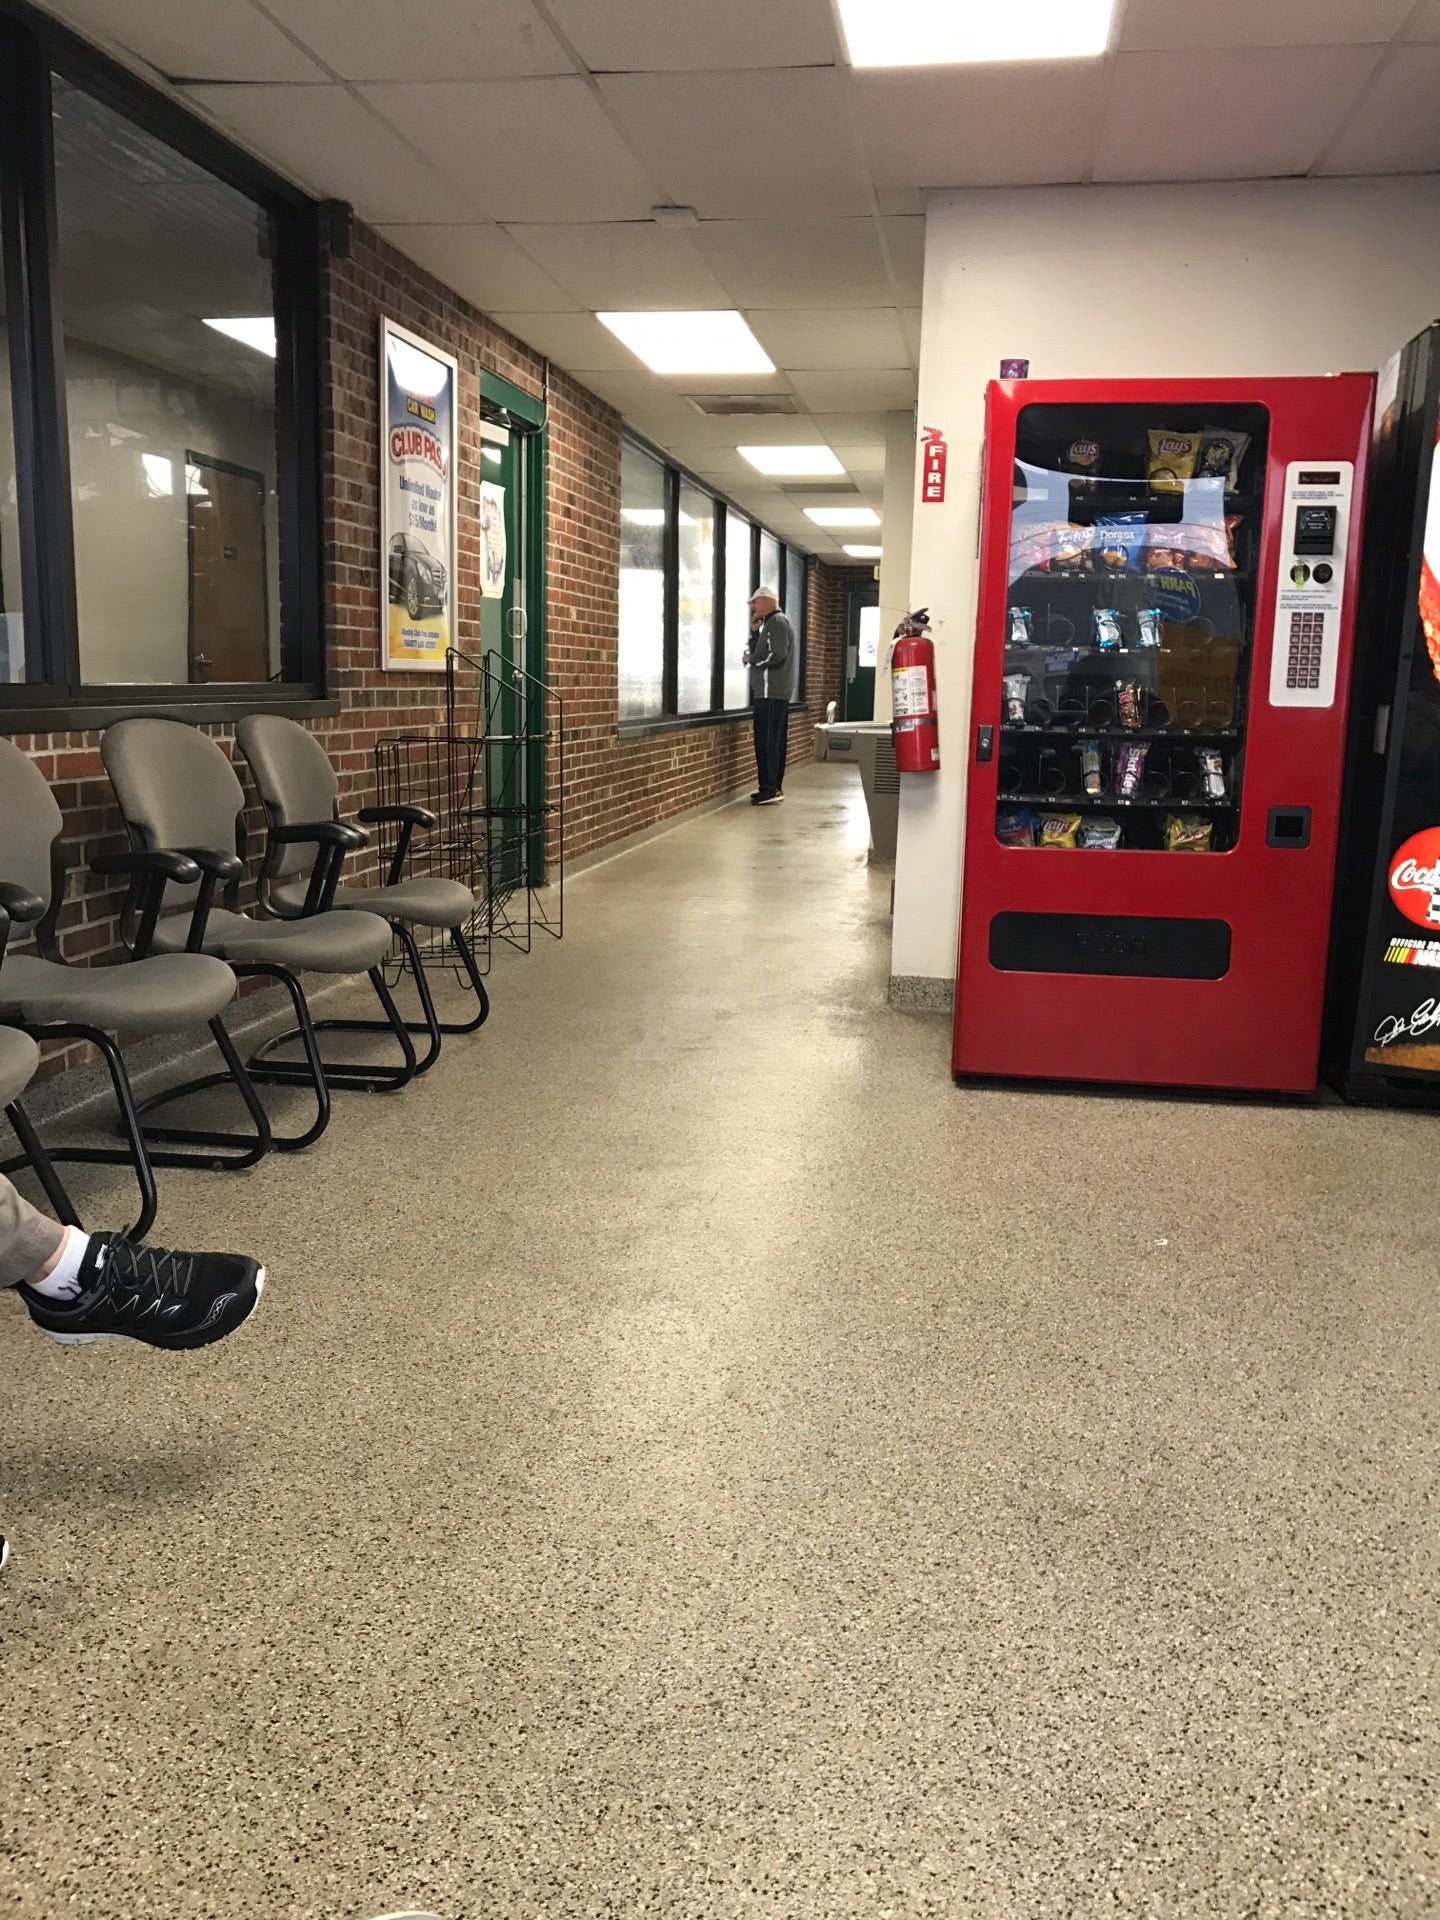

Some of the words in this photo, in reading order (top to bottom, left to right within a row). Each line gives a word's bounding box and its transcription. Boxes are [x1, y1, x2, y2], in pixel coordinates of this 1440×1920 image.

[391, 430, 423, 457] CLUB
[927, 445, 943, 497] FIRE
[1100, 530, 1135, 543] Doritos
[1390, 937, 1426, 950] OFFICIAL
